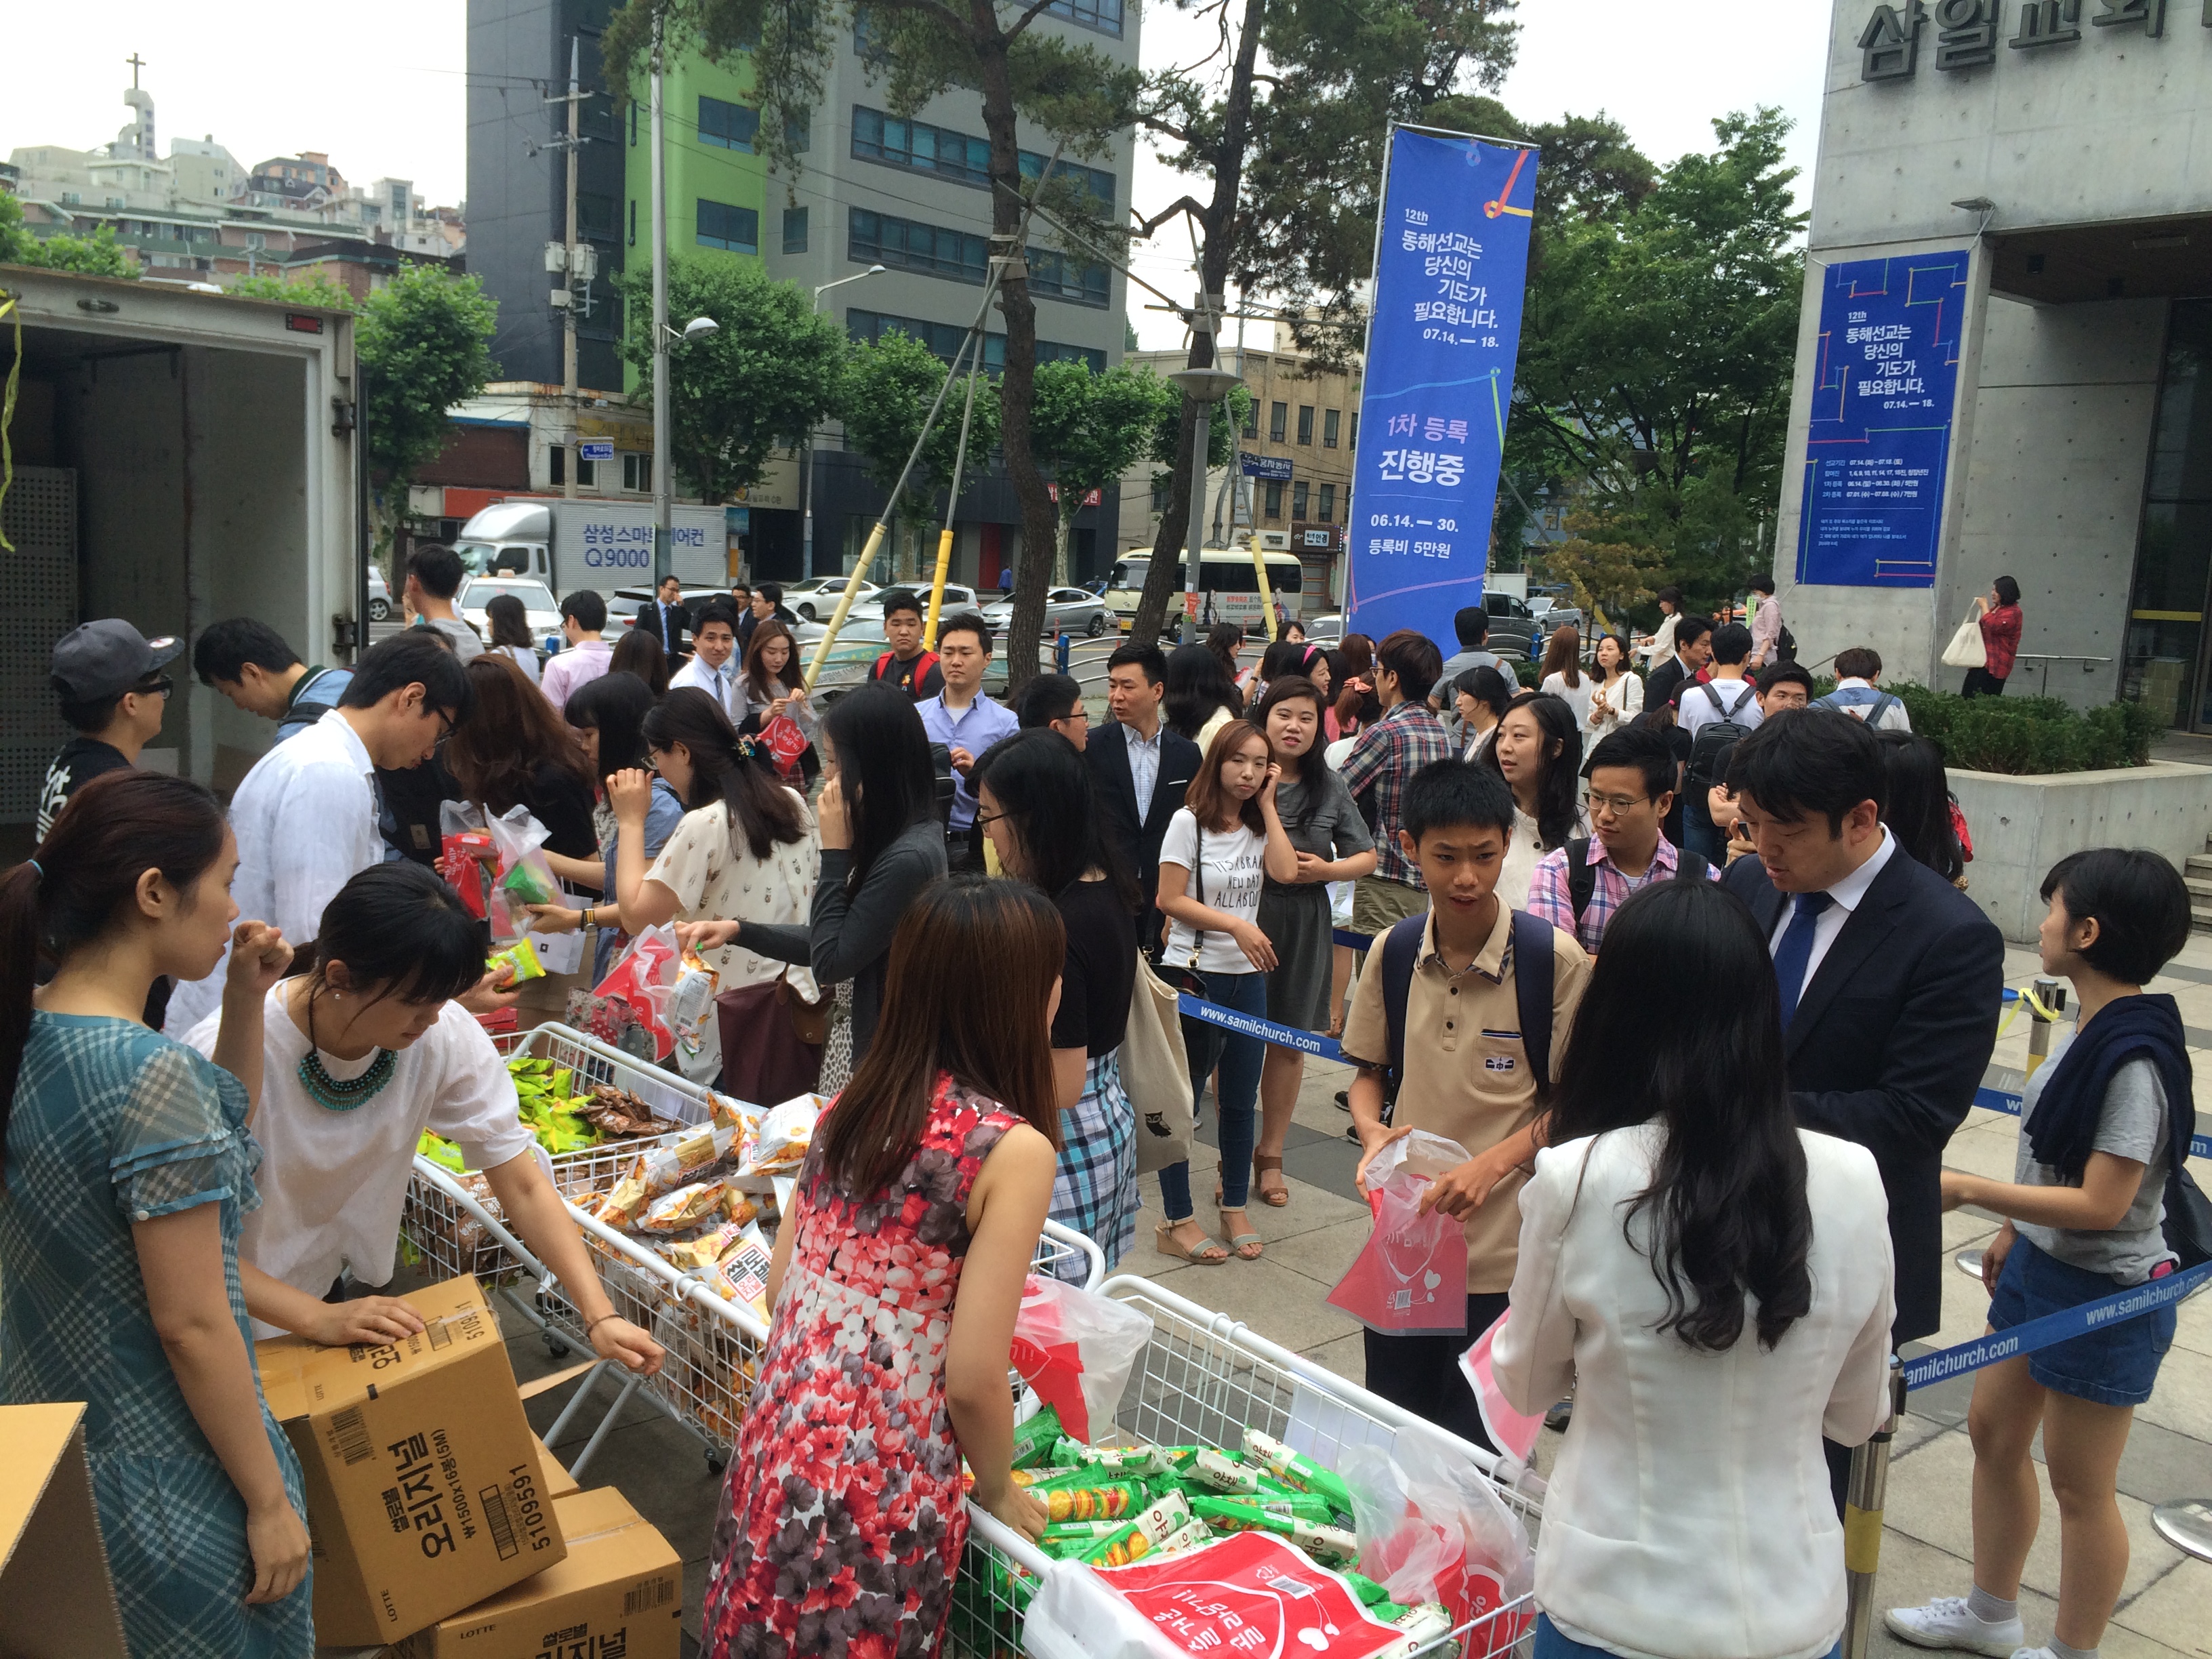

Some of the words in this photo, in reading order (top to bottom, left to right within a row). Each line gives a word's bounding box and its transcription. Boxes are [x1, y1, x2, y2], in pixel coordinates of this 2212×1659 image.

[1405, 208, 1429, 222] 12th
[1401, 229, 1483, 260] 동해선교는
[1425, 255, 1472, 281] 당신의
[1437, 278, 1488, 306] 기도가
[1414, 300, 1499, 329] 필요합니다.
[1848, 310, 1867, 321] 12th
[1481, 336, 1499, 348] 18.
[1846, 324, 1912, 344] 동해선교는
[1864, 342, 1904, 361] 당신의
[1876, 360, 1917, 377] 기도가
[1858, 377, 1925, 396] 필요합니다.
[1388, 413, 1418, 437] 1차
[1424, 416, 1469, 445] 등록
[1378, 449, 1465, 487] 진행중
[1437, 518, 1459, 533] 30.
[586, 548, 649, 568] Q9000
[1368, 539, 1409, 555] 등록비
[1413, 541, 1451, 559] 5만원
[1227, 875, 1244, 890] NEW
[1246, 873, 1260, 889] DAY
[1214, 891, 1234, 908] ALL
[1236, 890, 1262, 908] ABOUT
[1200, 1006, 1321, 1052] www.samilchurch.com
[2086, 1270, 2207, 1326] www.samilchurch.com
[1903, 1336, 2018, 1387] amilchurch.com
[387, 1432, 457, 1559] 오리지널
[509, 1463, 551, 1552] 5109591
[381, 1486, 411, 1534] 쌀로별
[380, 1589, 398, 1622] LOTTE
[459, 1624, 497, 1640] LOTTE
[542, 1622, 588, 1649] 쌀로별
[1153, 1607, 1221, 1652] 즐거운
